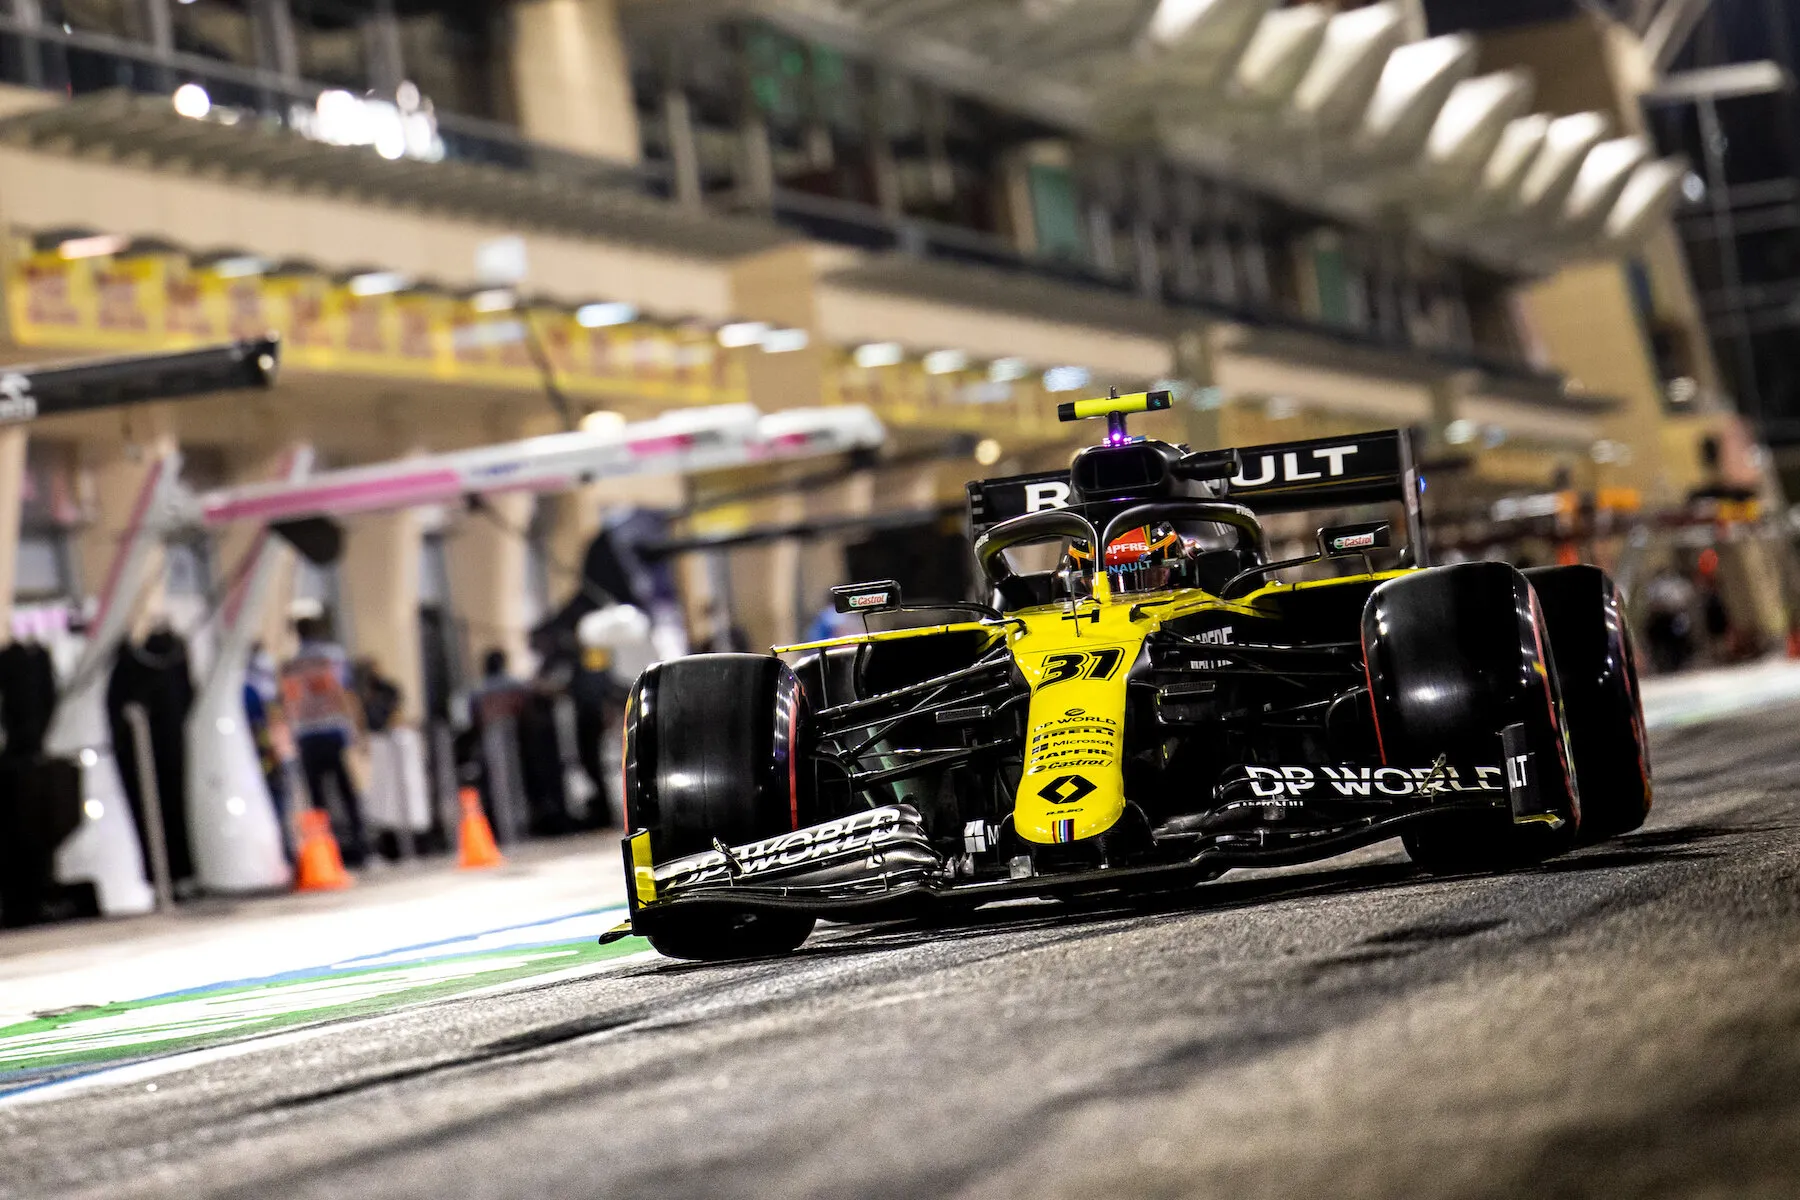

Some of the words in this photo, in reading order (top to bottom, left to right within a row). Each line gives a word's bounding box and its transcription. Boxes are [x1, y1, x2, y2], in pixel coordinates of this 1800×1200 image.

[1025, 444, 1358, 513] RULT
[1105, 541, 1149, 555] APFRE
[1345, 535, 1372, 547] Castrol
[1109, 560, 1152, 575] NAULT
[858, 595, 885, 605] Castrol
[1031, 647, 1125, 698] 31
[1057, 716, 1116, 725] WORLD
[1053, 739, 1115, 748] Microsoft
[1030, 749, 1114, 764] MAPFRE
[1048, 760, 1105, 770] Castrol
[1244, 765, 1315, 797] DP
[1320, 766, 1503, 796] WORLD
[664, 853, 727, 891] DP
[736, 808, 901, 874] WORLD
